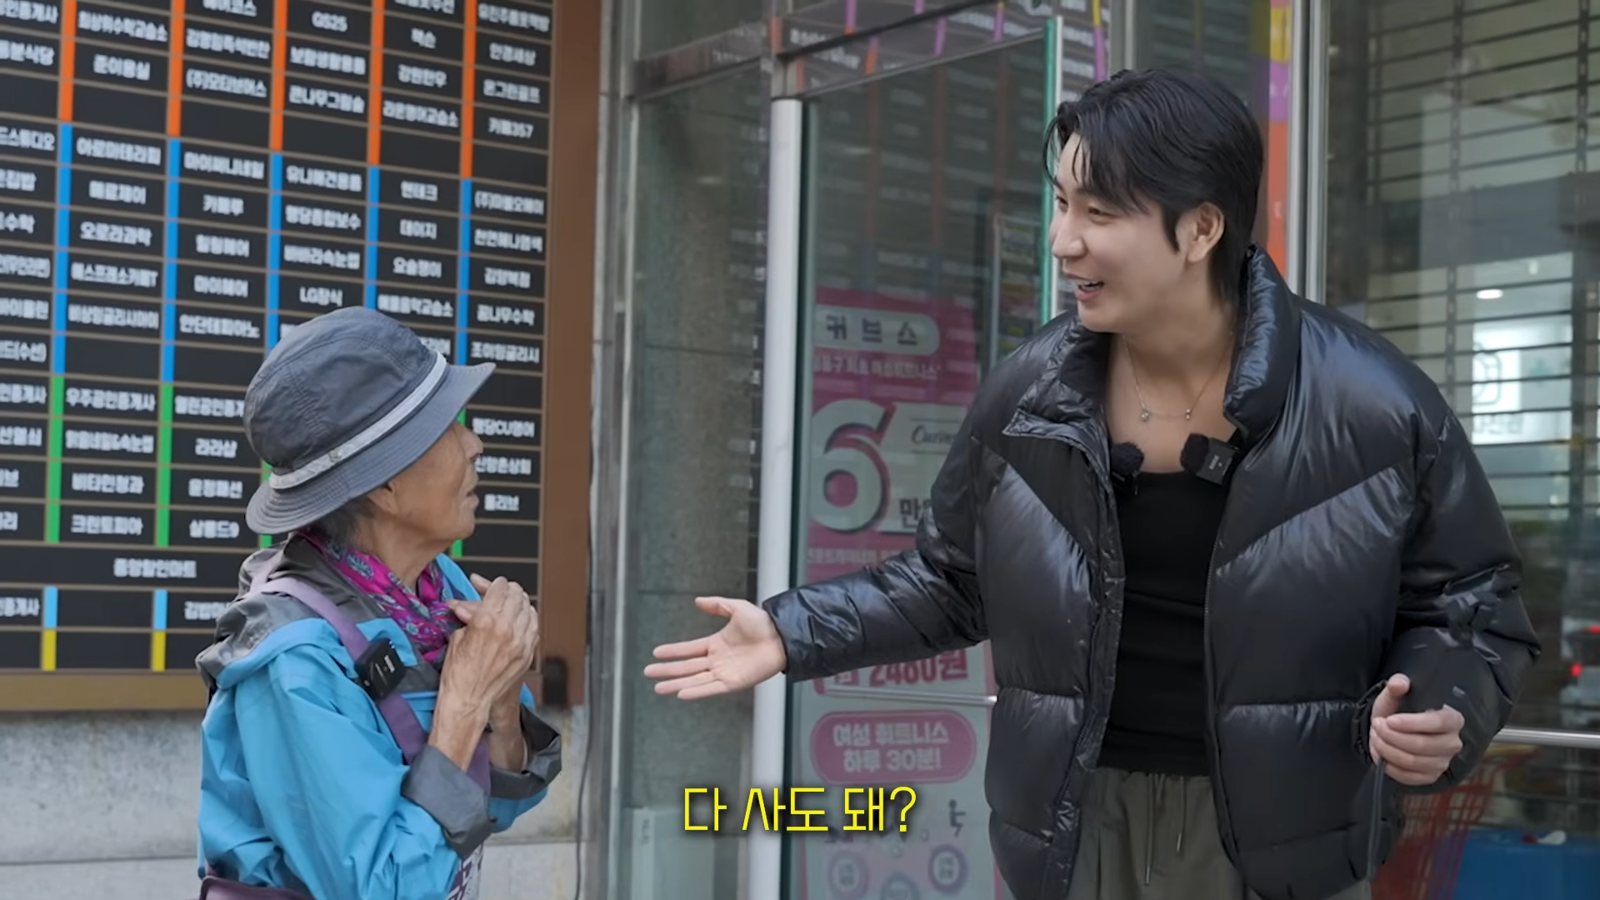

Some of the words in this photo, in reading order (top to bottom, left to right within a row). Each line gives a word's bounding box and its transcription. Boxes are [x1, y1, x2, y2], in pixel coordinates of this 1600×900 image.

[313, 12, 347, 31] GS25
[77, 138, 160, 164] 아로마테라피
[0, 212, 34, 233] 수학
[67, 389, 155, 410] 우주공인중개사
[811, 399, 890, 533] 6
[72, 515, 142, 534] 크린토피아
[0, 598, 39, 616] 중개사
[833, 722, 870, 747] 여성
[875, 721, 950, 746] 휘트니스
[843, 749, 880, 773] 하루
[886, 748, 942, 771] 30분!
